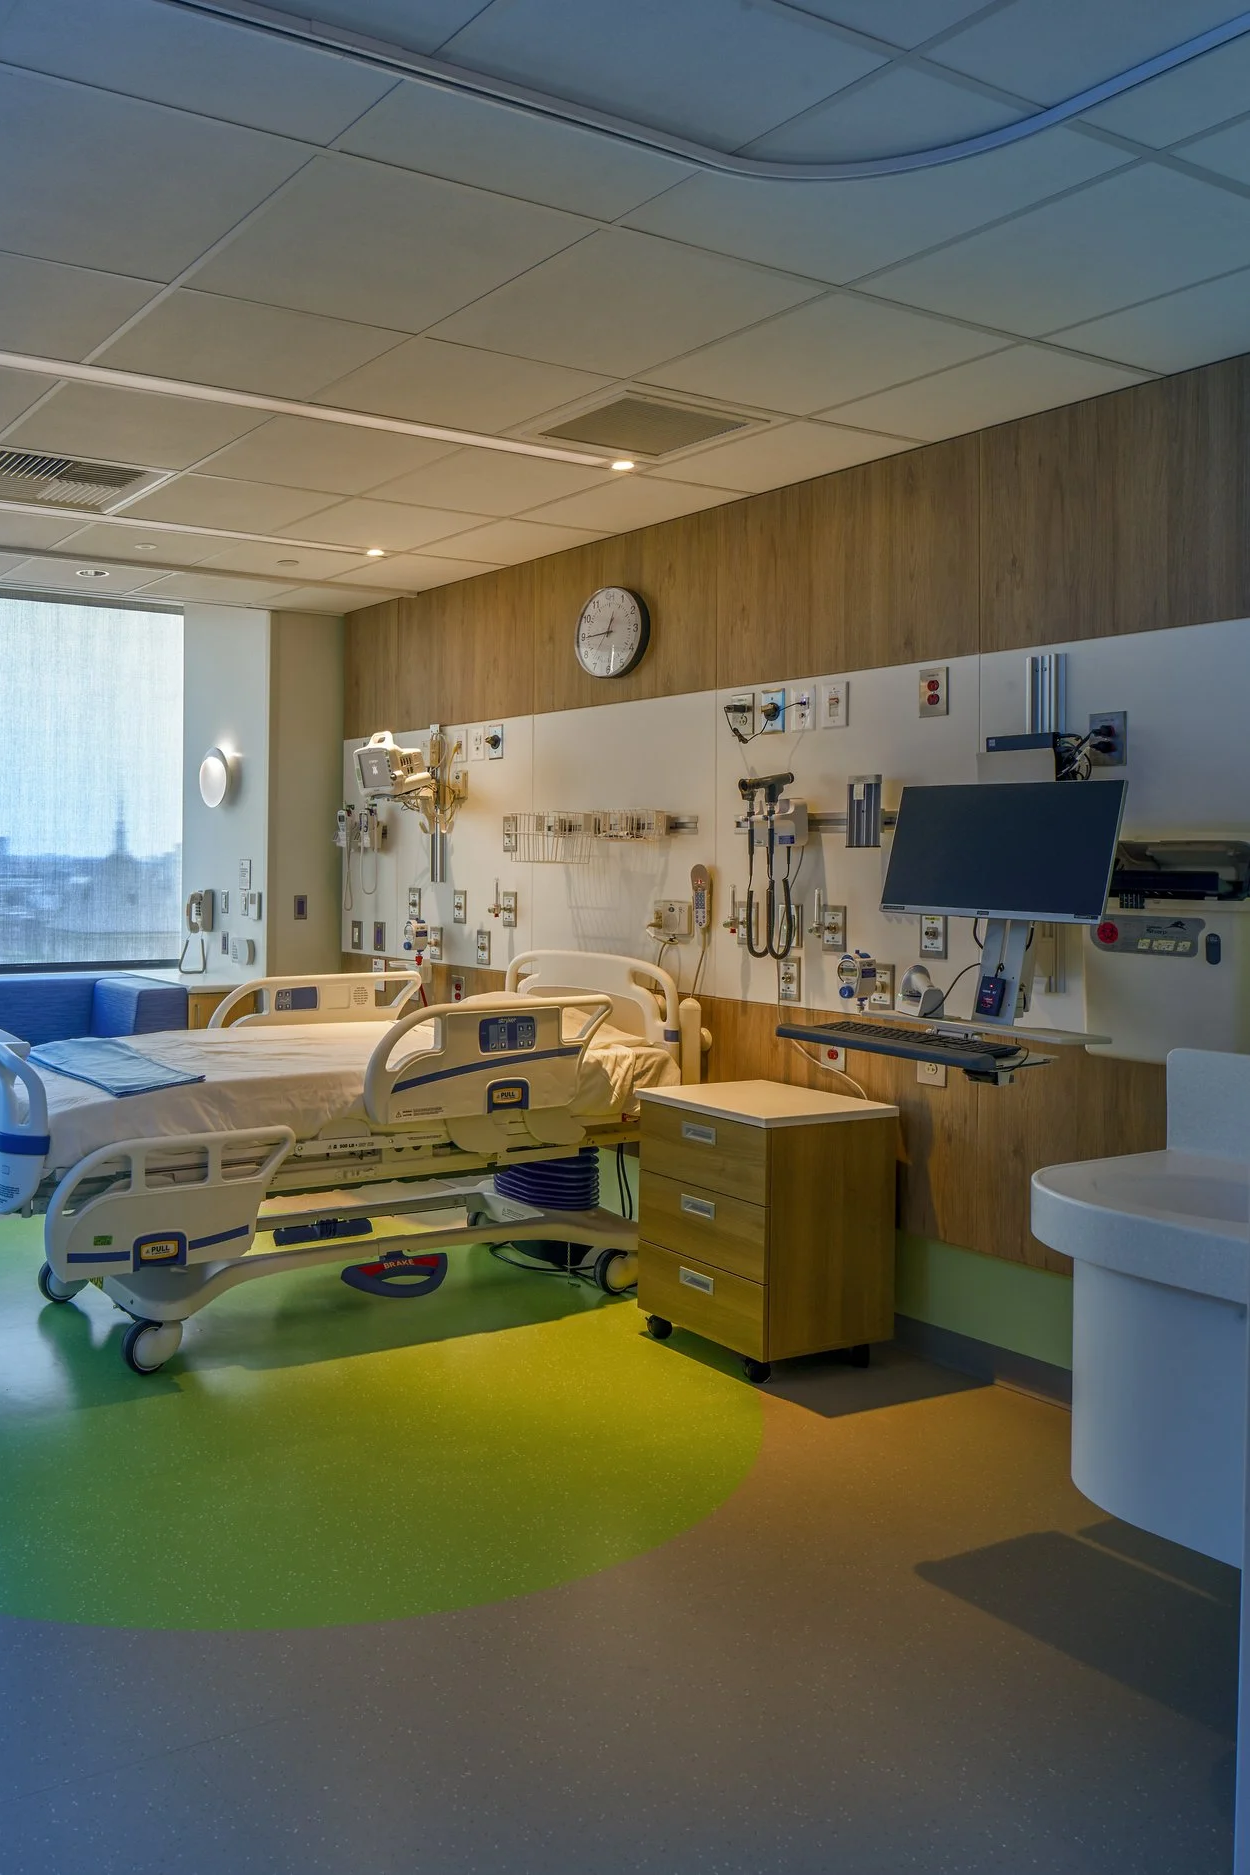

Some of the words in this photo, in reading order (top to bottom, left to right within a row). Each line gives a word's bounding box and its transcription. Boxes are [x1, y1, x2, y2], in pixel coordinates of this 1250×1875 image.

[592, 601, 600, 609] 11
[630, 605, 636, 615] 2
[583, 614, 591, 624] 10
[633, 623, 639, 633] 3
[581, 633, 586, 642] 9
[629, 643, 635, 652] 4
[584, 650, 589, 659] 8
[593, 662, 598, 671] 7
[619, 659, 625, 668] 5
[606, 665, 611, 674] 6
[151, 1244, 170, 1252] PULL
[383, 1258, 415, 1269] BRAKE
